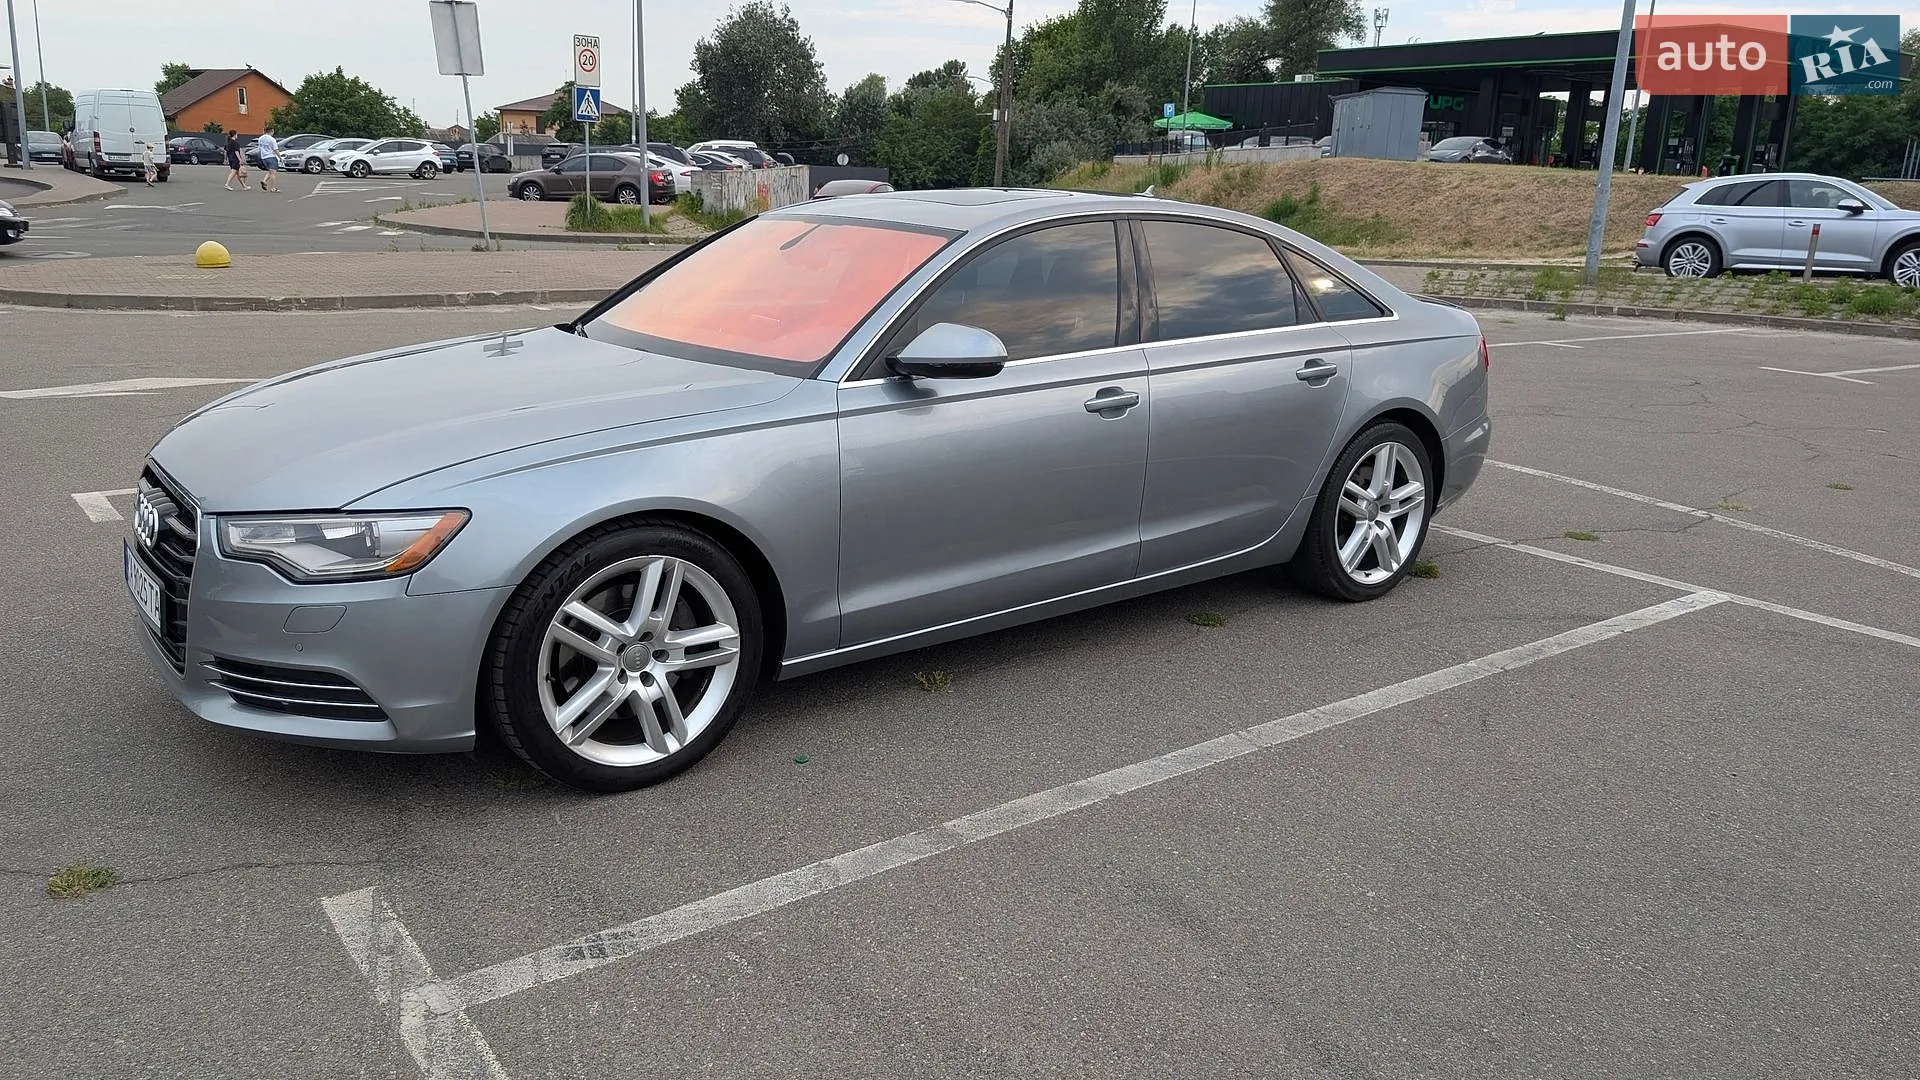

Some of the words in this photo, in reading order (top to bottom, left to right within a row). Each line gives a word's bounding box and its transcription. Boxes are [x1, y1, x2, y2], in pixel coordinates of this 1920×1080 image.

[575, 36, 599, 49] ЗОНА
[582, 54, 594, 66] 20
[1429, 95, 1465, 111] UPG
